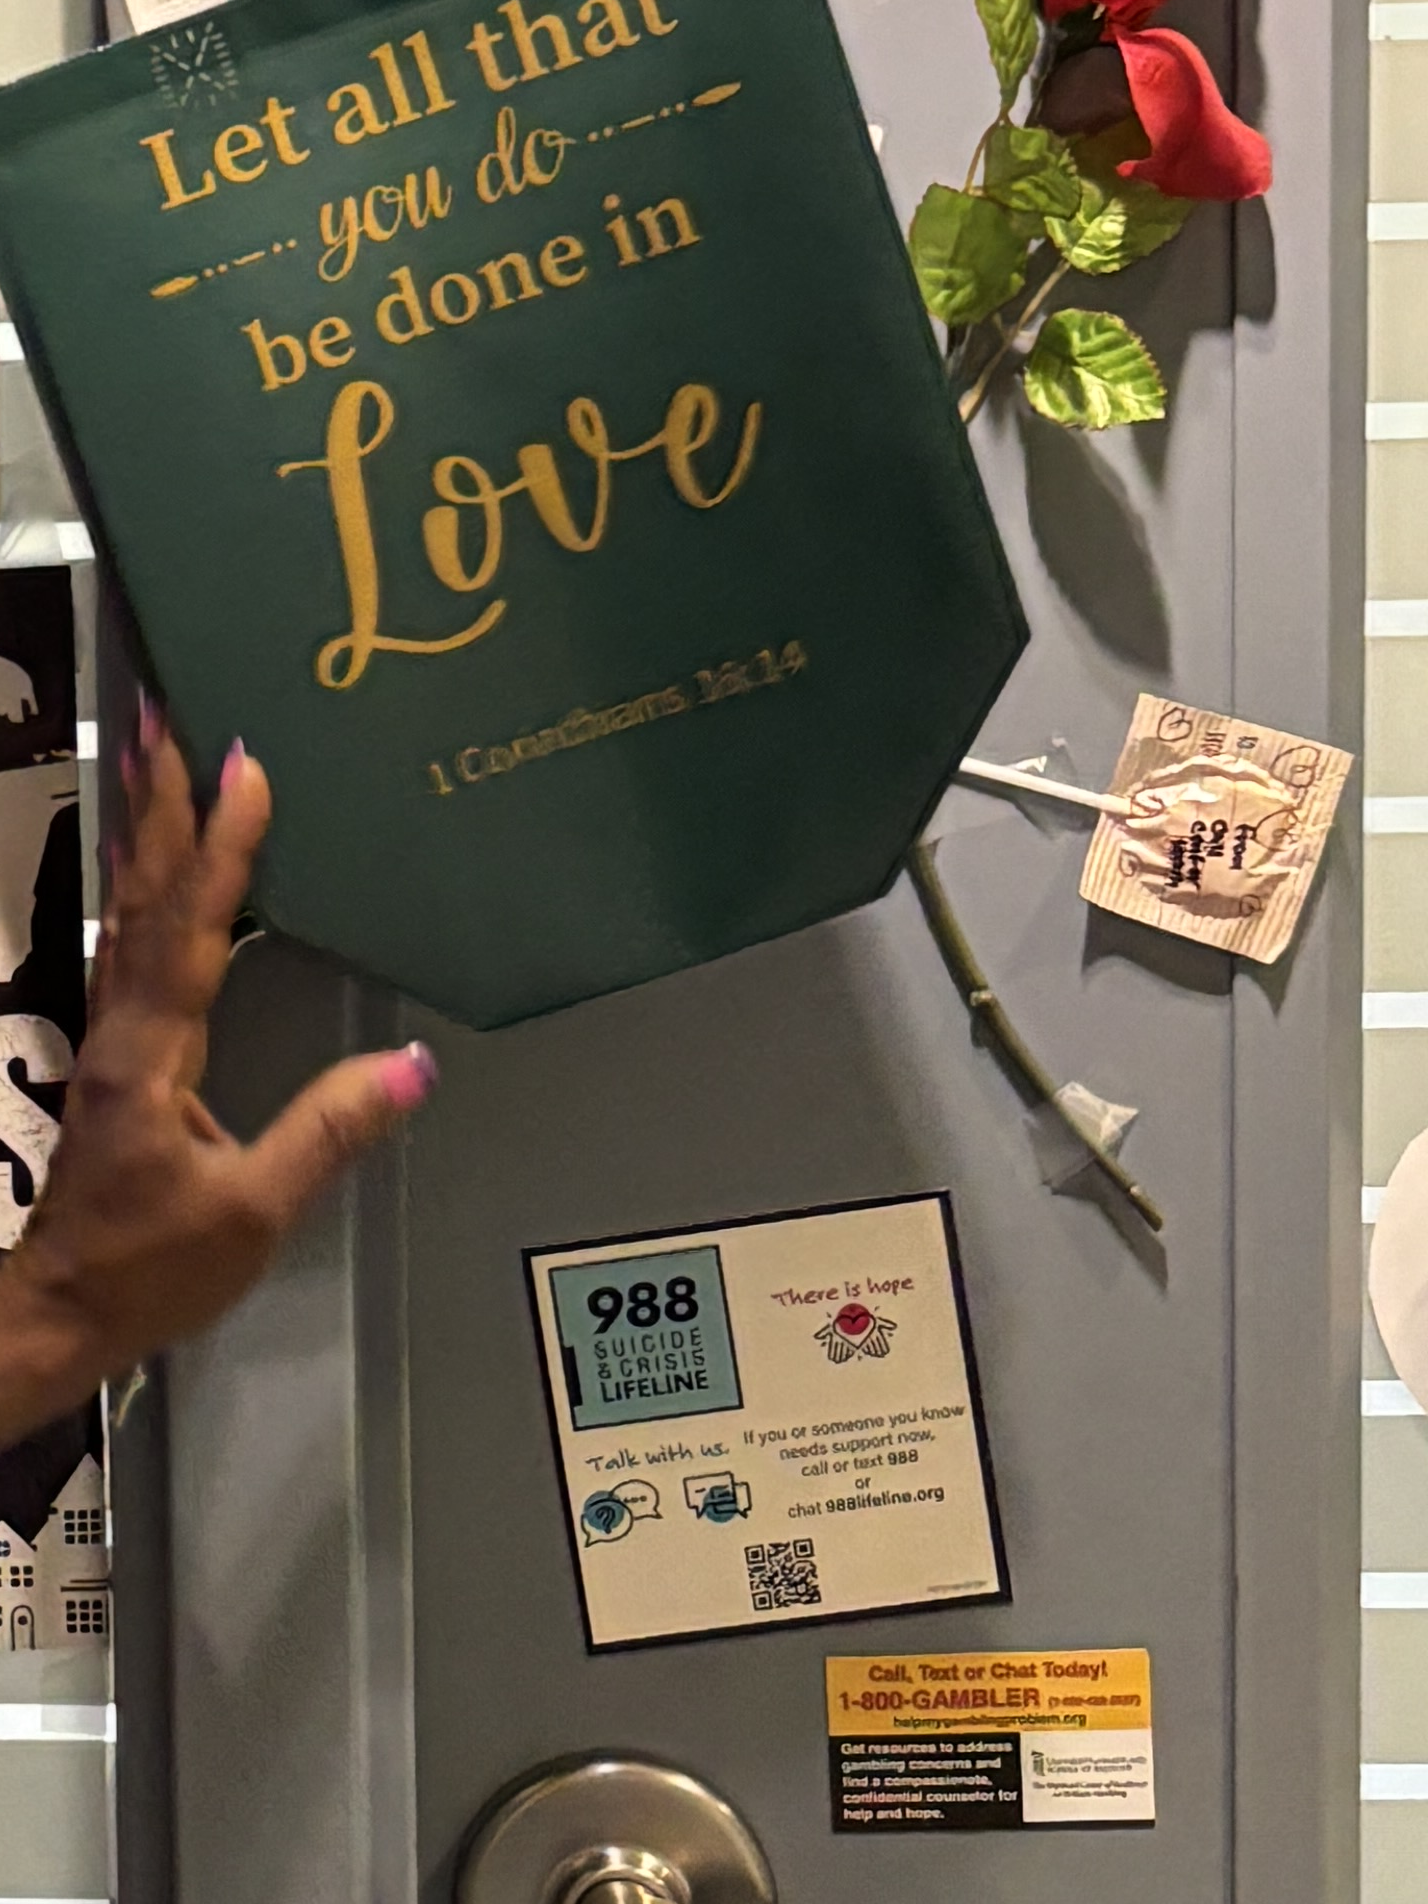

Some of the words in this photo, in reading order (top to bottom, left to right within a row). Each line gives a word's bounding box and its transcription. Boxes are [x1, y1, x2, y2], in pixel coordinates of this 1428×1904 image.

[139, 95, 311, 210] Let
[327, 30, 457, 146] all
[316, 155, 455, 284] you
[477, 103, 579, 206] do
[243, 313, 357, 395] be
[375, 224, 591, 349] done
[602, 191, 704, 268] in
[278, 377, 764, 694] Love
[771, 1288, 838, 1307] There
[844, 1281, 862, 1299] is
[867, 1276, 916, 1301] hope
[587, 1276, 699, 1336] 988
[594, 1328, 702, 1360] SUICIDE
[620, 1350, 706, 1376] CRISIS
[600, 1370, 710, 1403] LIFELINE
[758, 1428, 787, 1447] you
[888, 1412, 917, 1429] you
[921, 1404, 966, 1421] know
[831, 1433, 893, 1454] support
[586, 1447, 640, 1472] Talk
[646, 1444, 694, 1468] with
[801, 1460, 829, 1477] call
[833, 1459, 849, 1473] or
[887, 1449, 919, 1466] 988
[855, 1477, 872, 1490] or
[787, 1502, 822, 1520] chat
[919, 1664, 960, 1681] Text
[964, 1666, 986, 1681] or
[990, 1662, 1038, 1680] Chat
[1042, 1660, 1109, 1681] Today!
[839, 1688, 1041, 1711] 1-800-GAMBLER
[841, 1743, 865, 1755] Get
[868, 1743, 937, 1754] resources
[940, 1742, 954, 1753] to
[957, 1741, 1013, 1753] address
[908, 1758, 972, 1770] concerns
[976, 1758, 1002, 1769] and
[842, 1776, 868, 1787] find
[842, 1791, 922, 1804] confidential
[926, 1790, 994, 1802] counselor
[998, 1790, 1018, 1802] for
[843, 1808, 874, 1822] help
[876, 1808, 902, 1819] and
